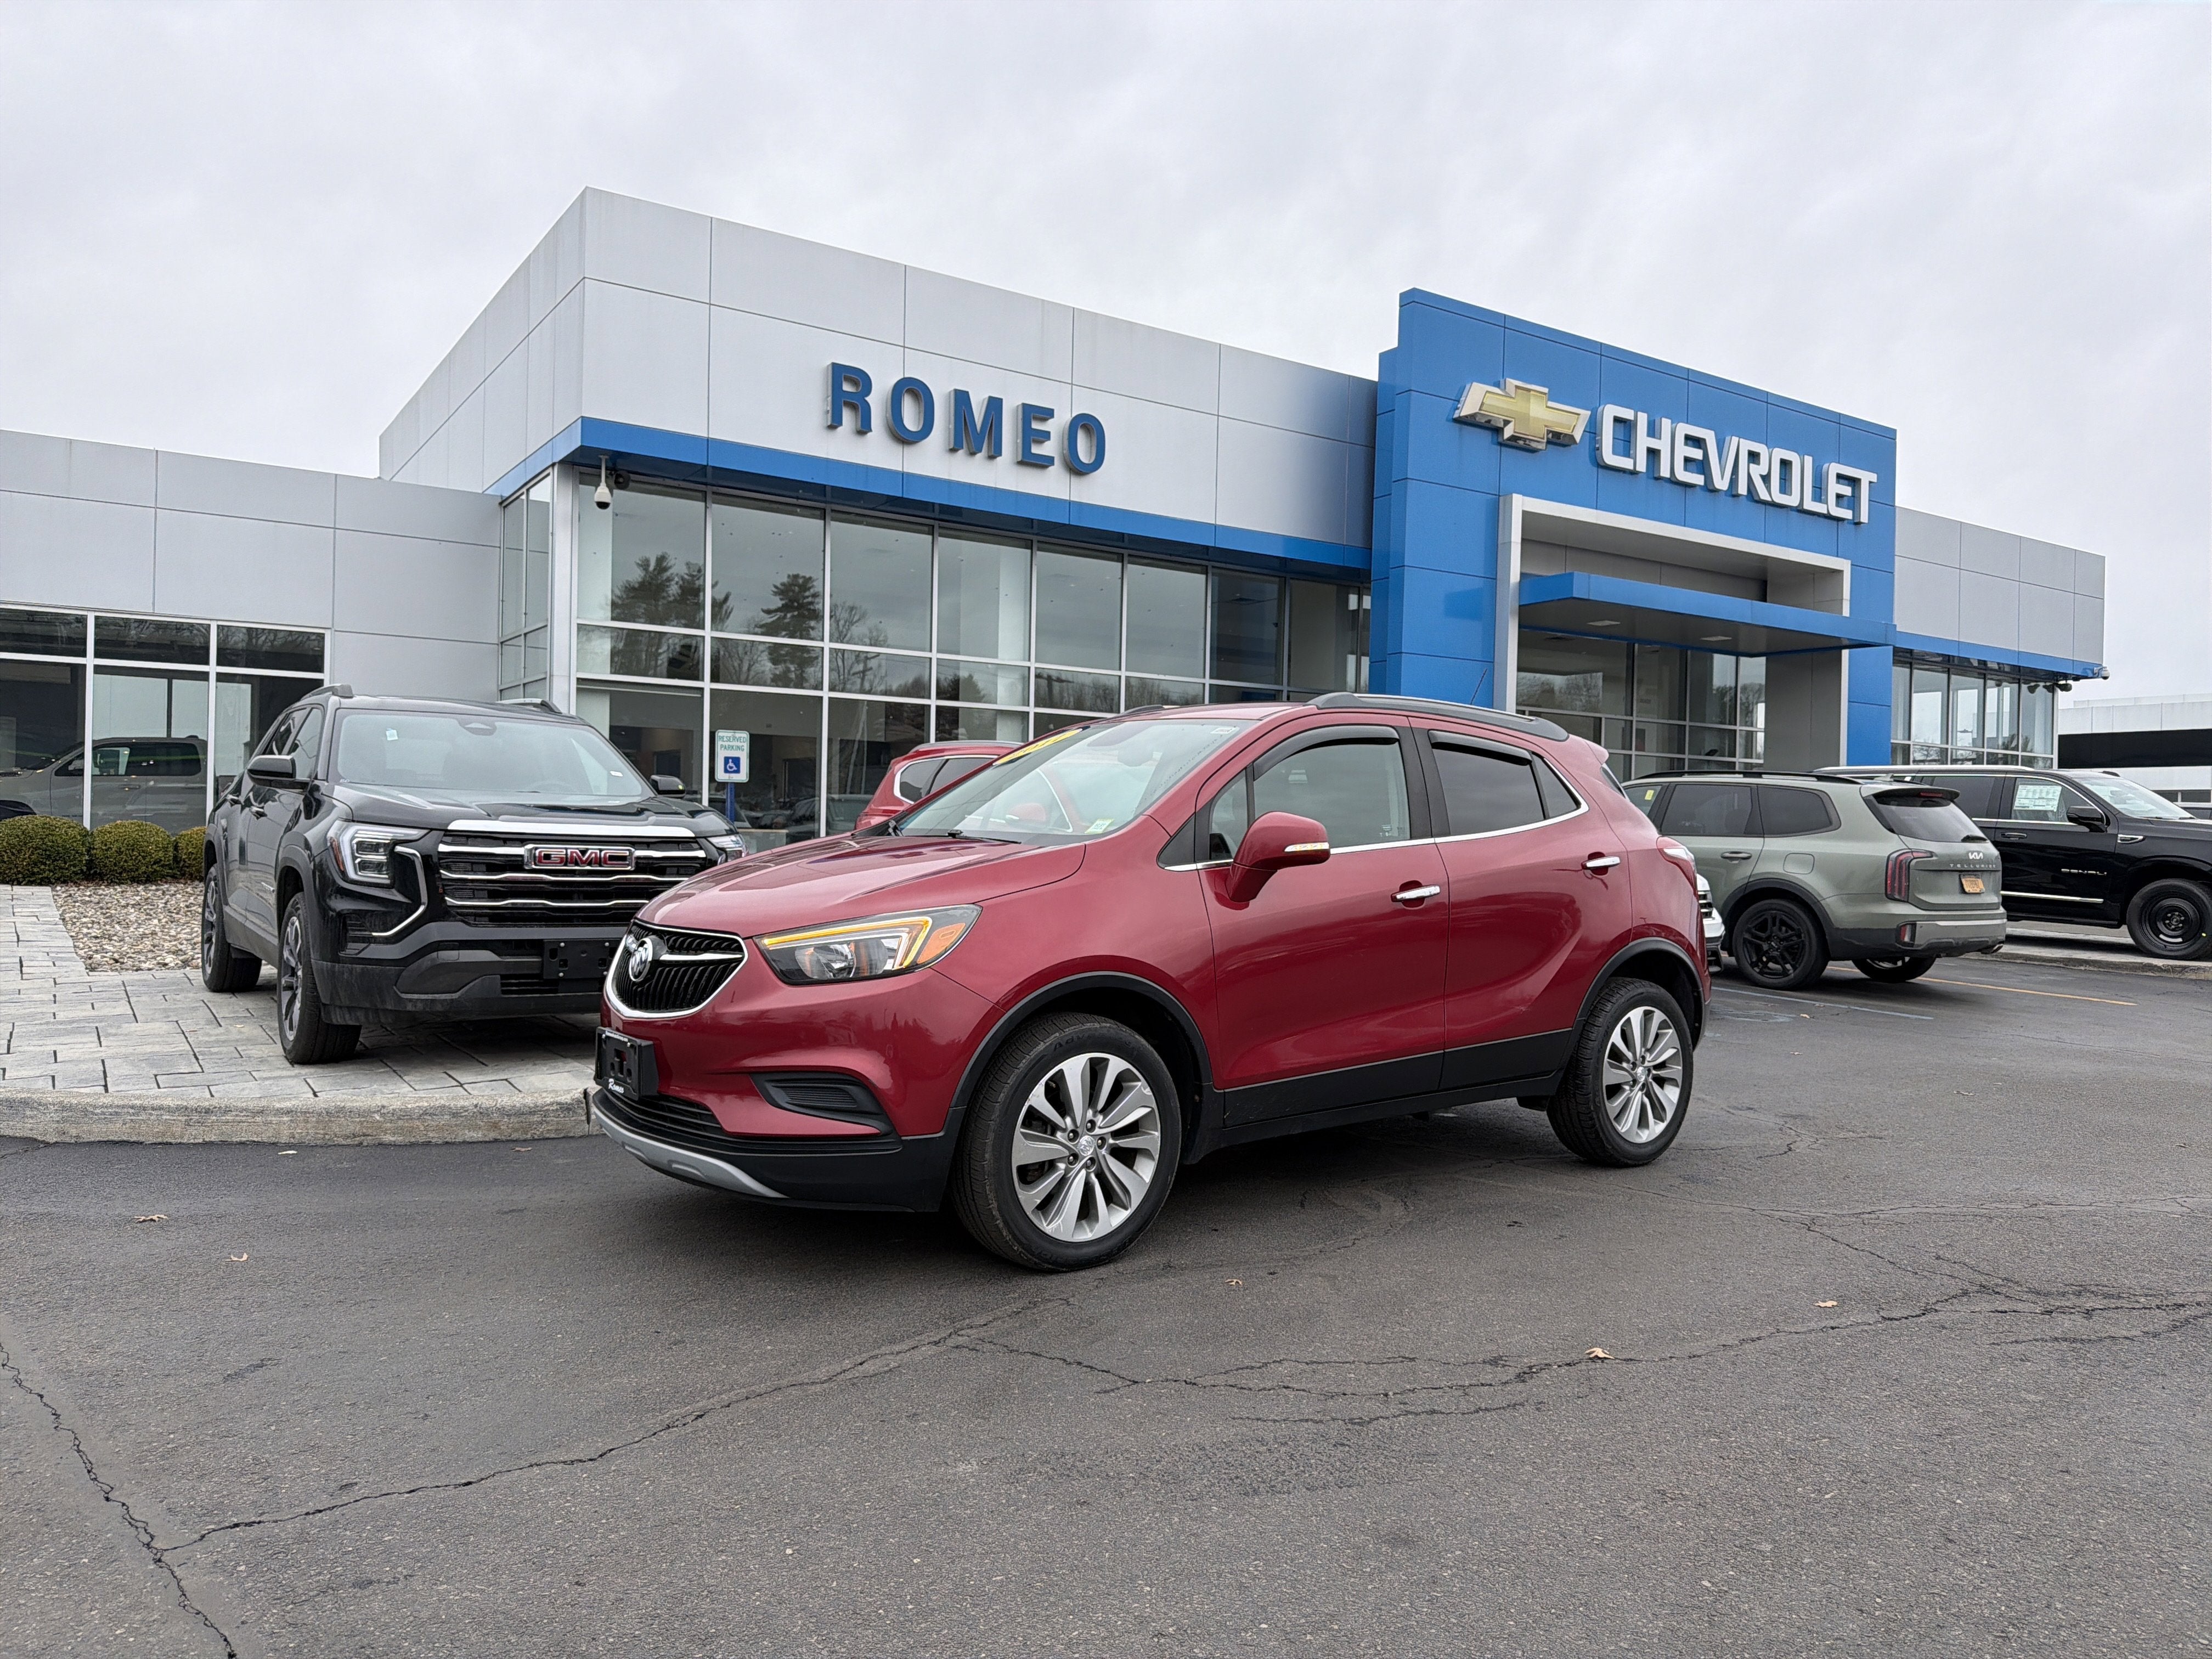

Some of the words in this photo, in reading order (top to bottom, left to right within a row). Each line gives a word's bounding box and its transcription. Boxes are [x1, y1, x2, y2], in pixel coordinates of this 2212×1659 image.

[827, 362, 1105, 475] ROMEO
[1596, 403, 1877, 525] CHEVROLET
[535, 848, 630, 867] GMC
